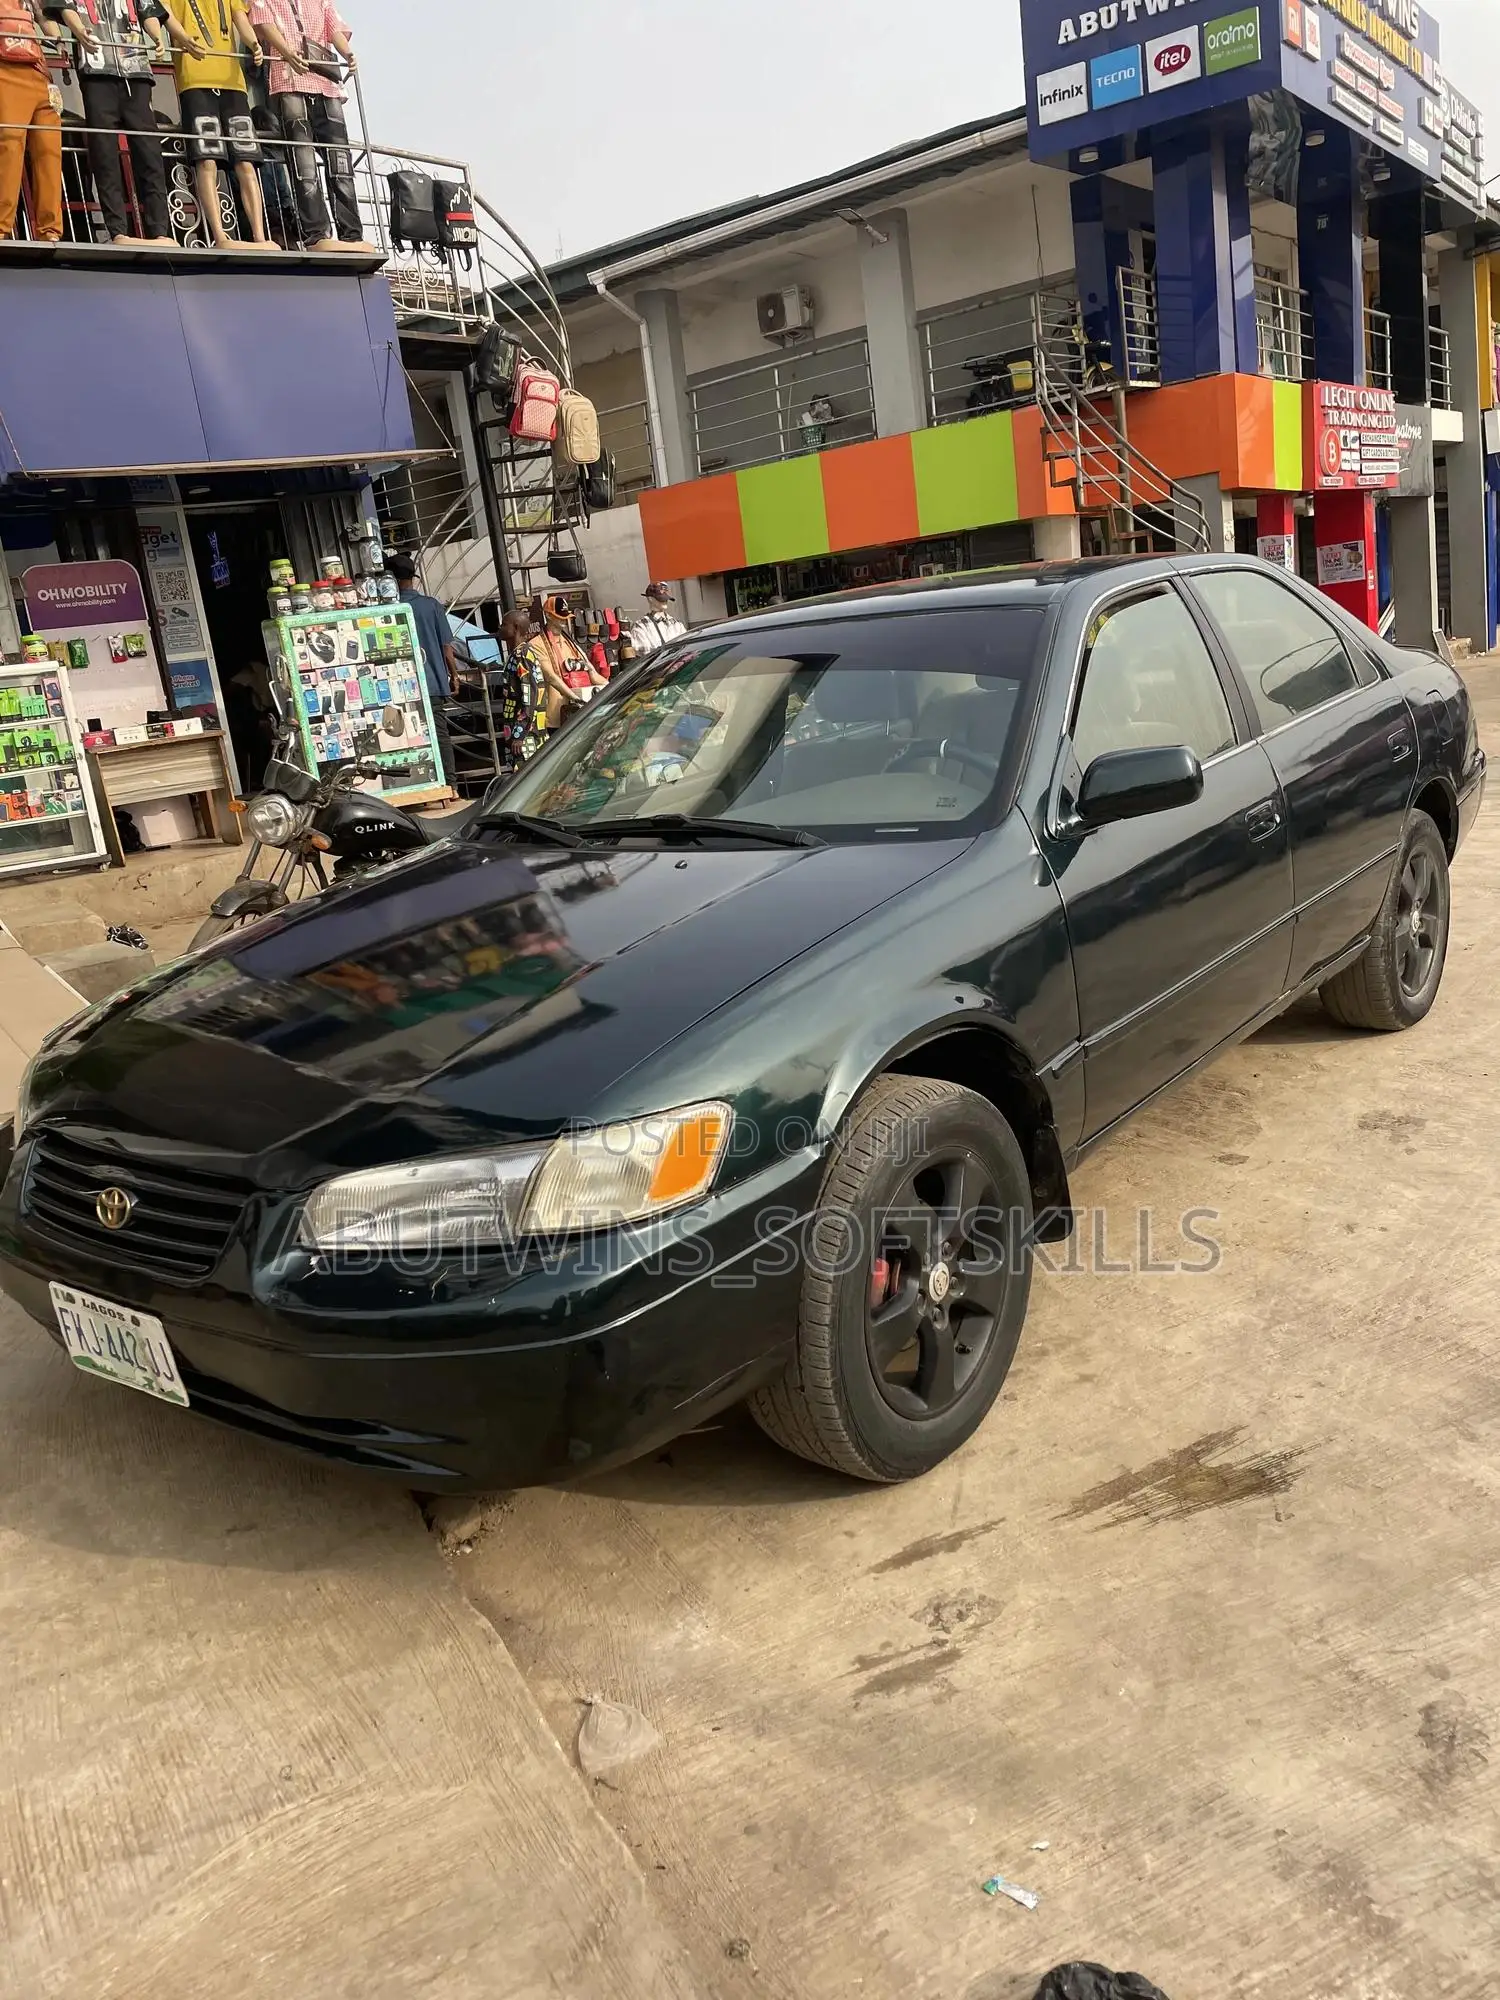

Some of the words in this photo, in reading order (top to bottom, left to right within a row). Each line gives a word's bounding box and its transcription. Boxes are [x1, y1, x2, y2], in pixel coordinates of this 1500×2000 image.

[1057, 0, 1199, 44] ABUTW
[1207, 22, 1255, 49] oraimo
[1159, 47, 1187, 70] itel
[1096, 67, 1136, 88] TECNO
[1039, 84, 1084, 107] infinix
[1325, 386, 1356, 409] LEGIT
[1360, 390, 1396, 412] ONLINE
[1327, 410, 1367, 427] TRADING
[1382, 415, 1397, 429] LTD
[55, 598, 117, 609] www.ohmobility.com
[354, 821, 396, 834] QLINK
[81, 1298, 126, 1321] LAGOS
